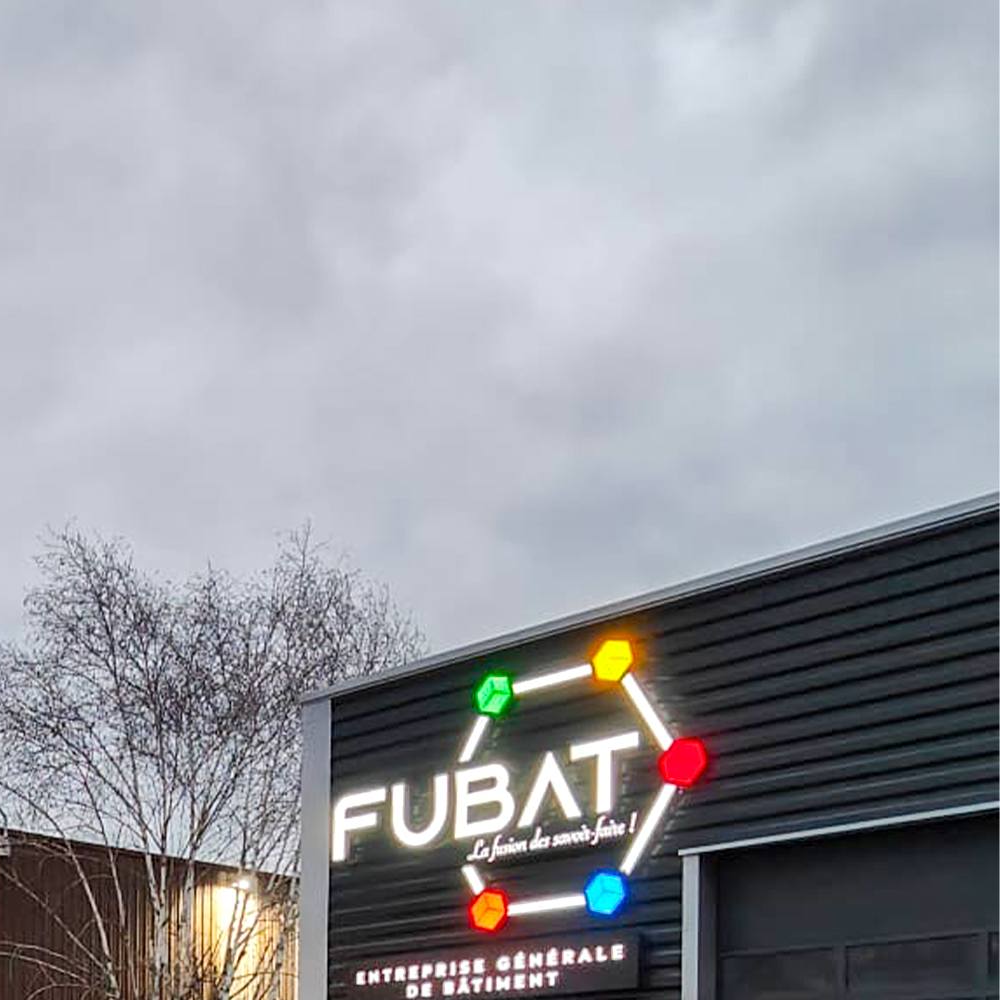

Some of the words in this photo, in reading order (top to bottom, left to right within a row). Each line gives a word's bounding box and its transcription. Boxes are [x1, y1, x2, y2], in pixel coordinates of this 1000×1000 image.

[331, 731, 639, 862] FUBAT
[466, 838, 489, 861] La
[488, 834, 528, 862] fusion
[529, 826, 551, 849] des
[355, 958, 486, 986] ENTREPRISE
[496, 943, 625, 971] GÉNÉRALE
[405, 982, 433, 999] DE
[442, 970, 560, 996] BÂTIMENT
